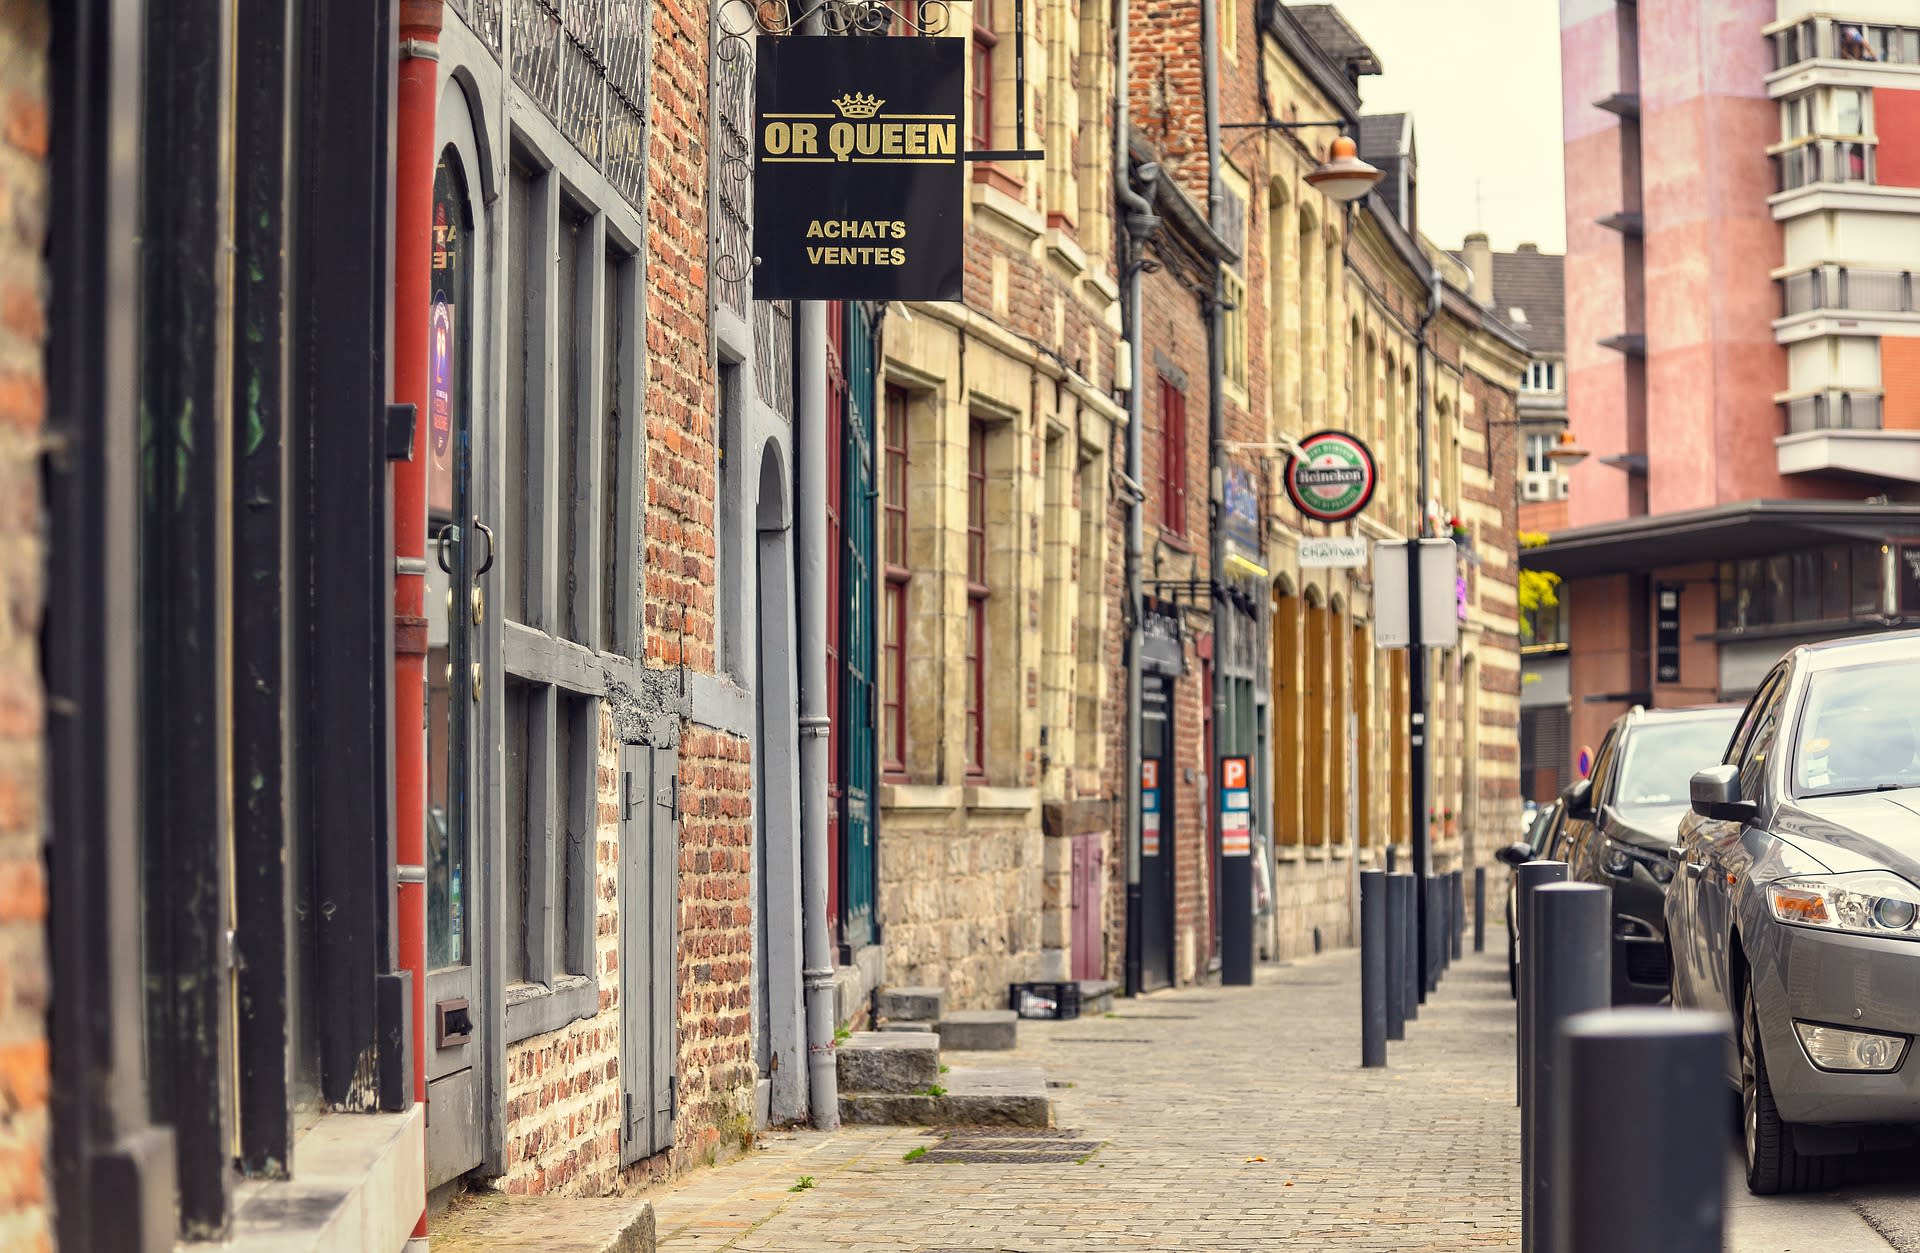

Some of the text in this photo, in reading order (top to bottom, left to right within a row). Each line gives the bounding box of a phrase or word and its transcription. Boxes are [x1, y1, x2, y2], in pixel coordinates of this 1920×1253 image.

[764, 122, 956, 162] OR QUEEN
[806, 220, 907, 239] ACHATS
[806, 247, 906, 265] VENTES
[1299, 469, 1361, 483] Heineken
[1227, 760, 1244, 786] P
